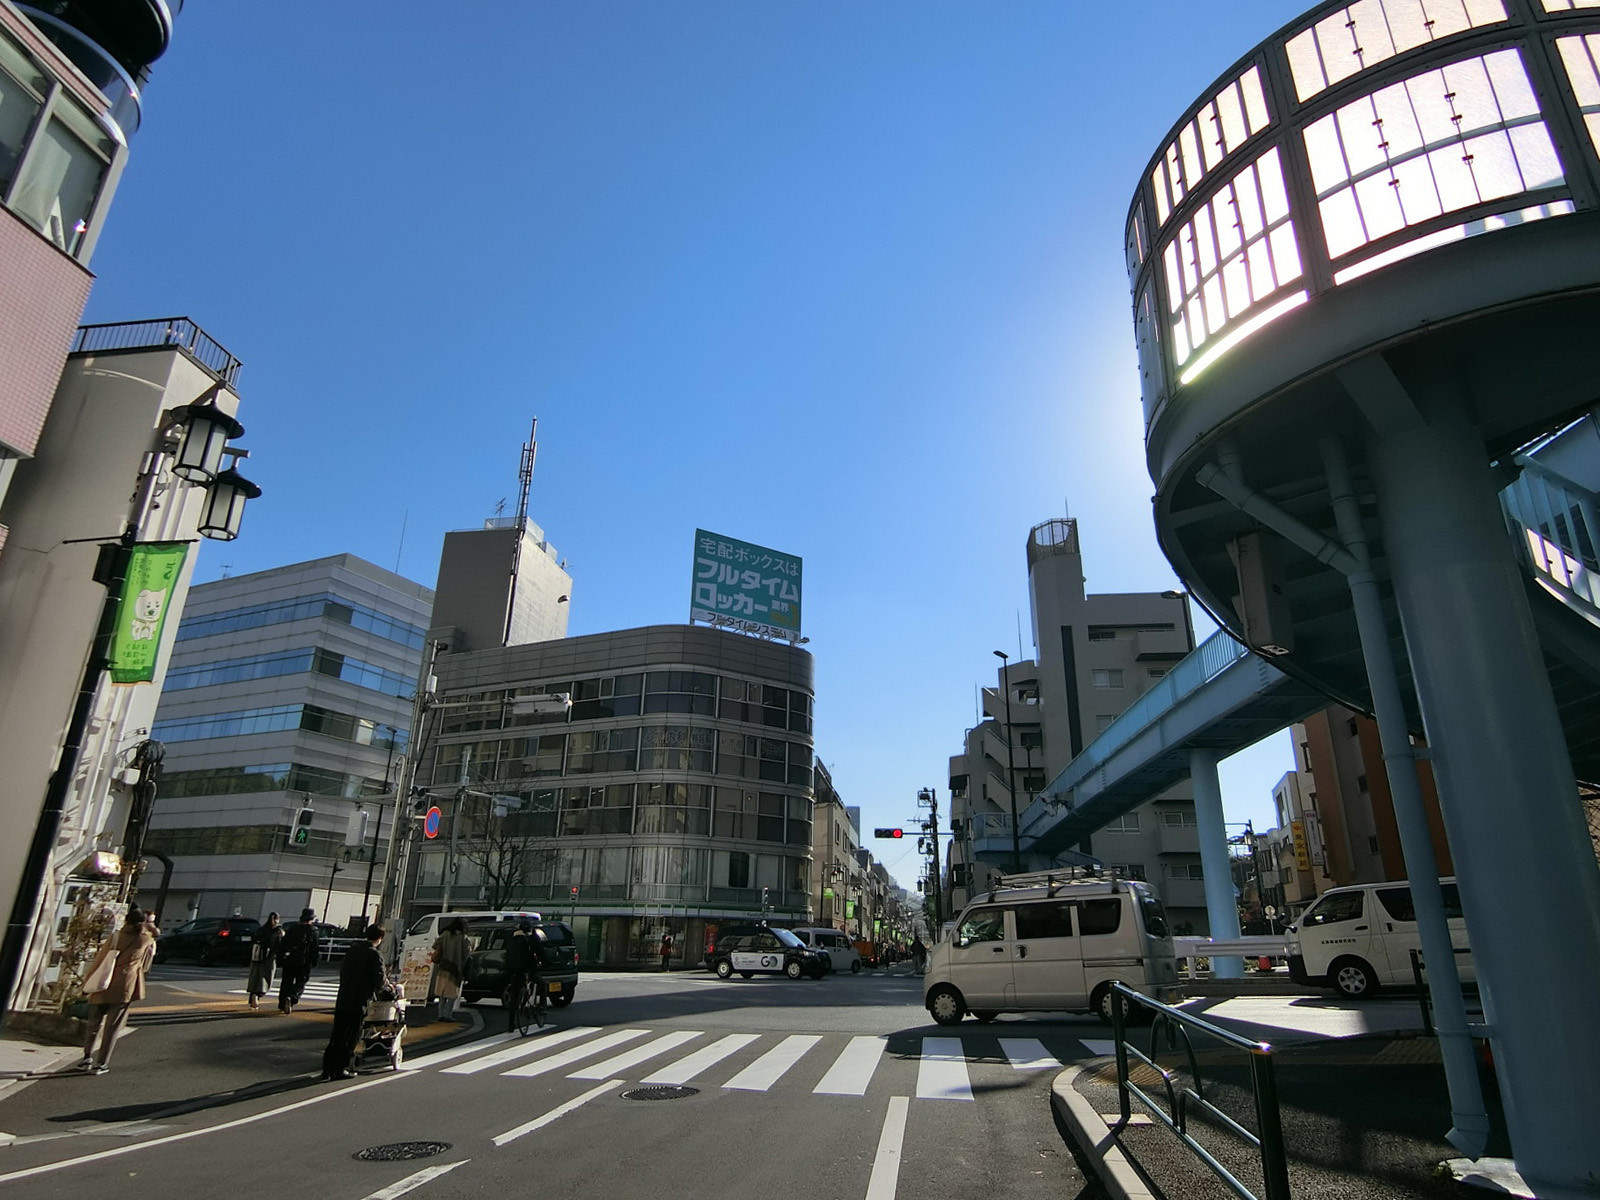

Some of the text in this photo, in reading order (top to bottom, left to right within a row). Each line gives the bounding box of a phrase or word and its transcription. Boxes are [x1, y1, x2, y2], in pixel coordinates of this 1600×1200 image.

[700, 537, 799, 577] 宅配ボックスは
[696, 556, 799, 602] フルタイム
[695, 582, 768, 615] ロッカー
[761, 955, 778, 968] GO
